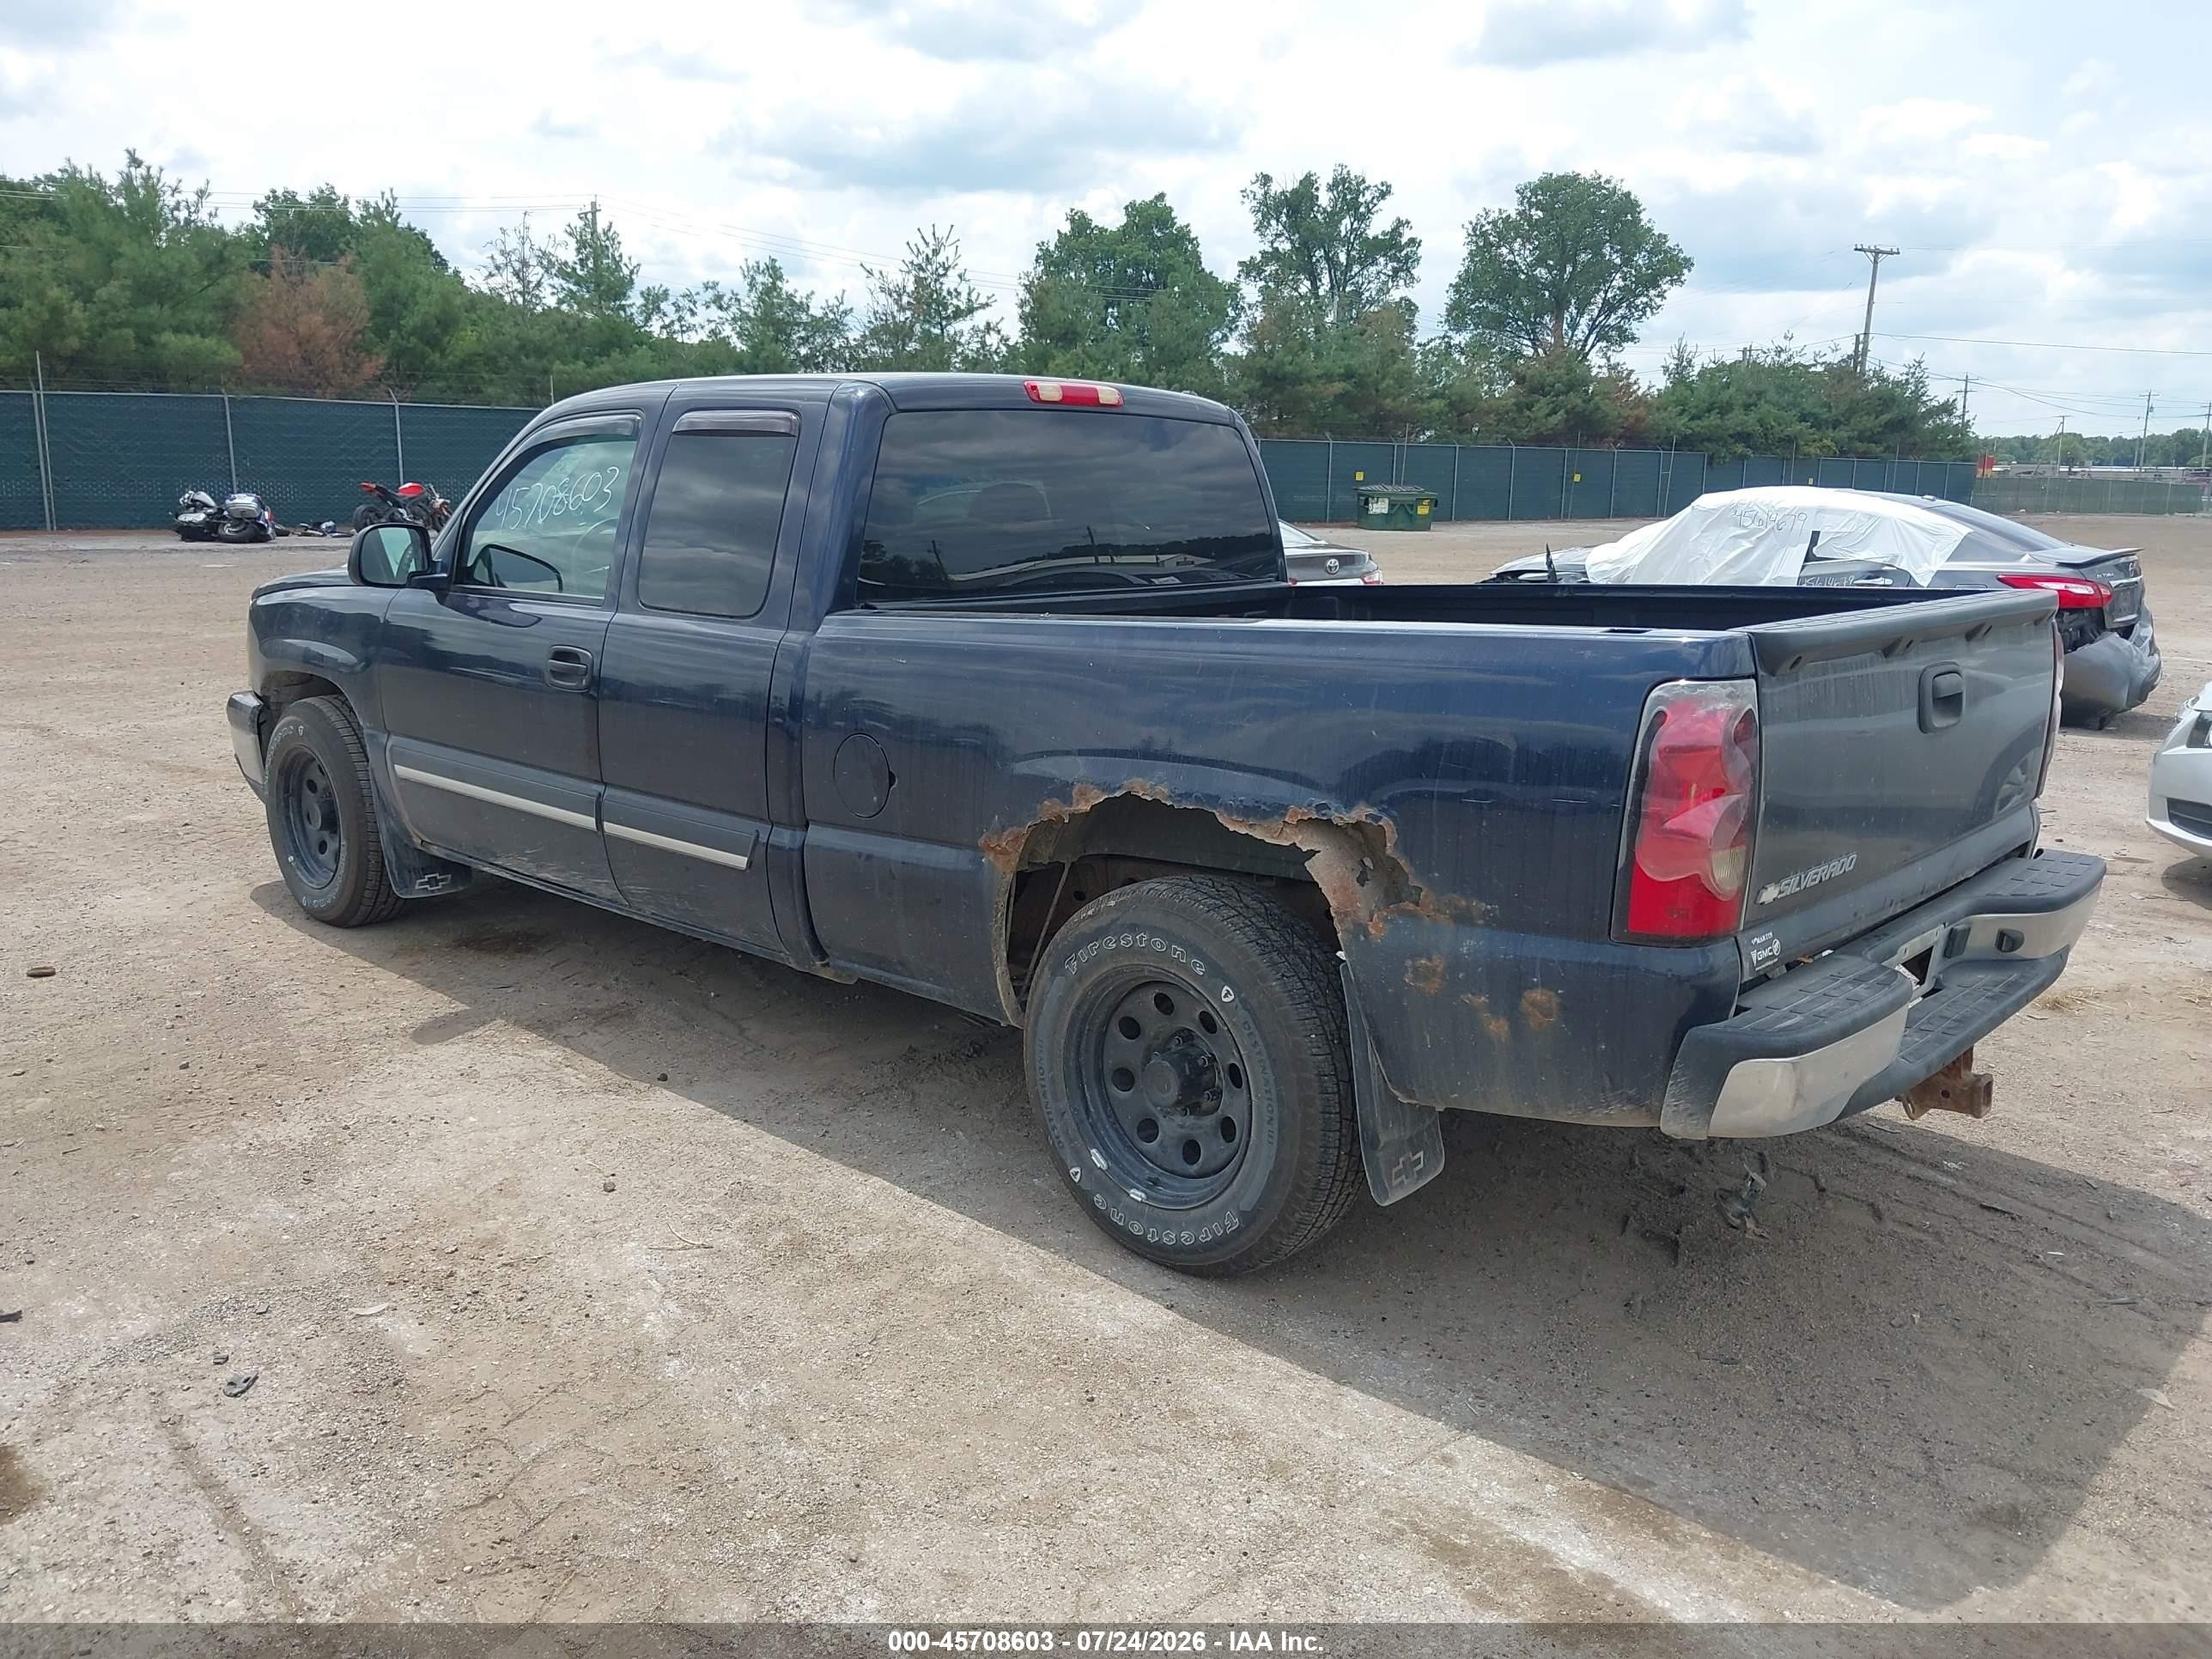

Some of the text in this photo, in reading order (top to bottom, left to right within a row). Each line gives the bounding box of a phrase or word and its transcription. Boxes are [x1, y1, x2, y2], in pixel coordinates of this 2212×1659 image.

[495, 466, 620, 530] 45708603
[1732, 509, 1808, 537] 45614679
[1778, 853, 1857, 899] SILVERADO
[1064, 933, 1206, 975] Firestone
[1757, 946, 1774, 961] GMC
[1092, 1194, 1240, 1245] Firestone
